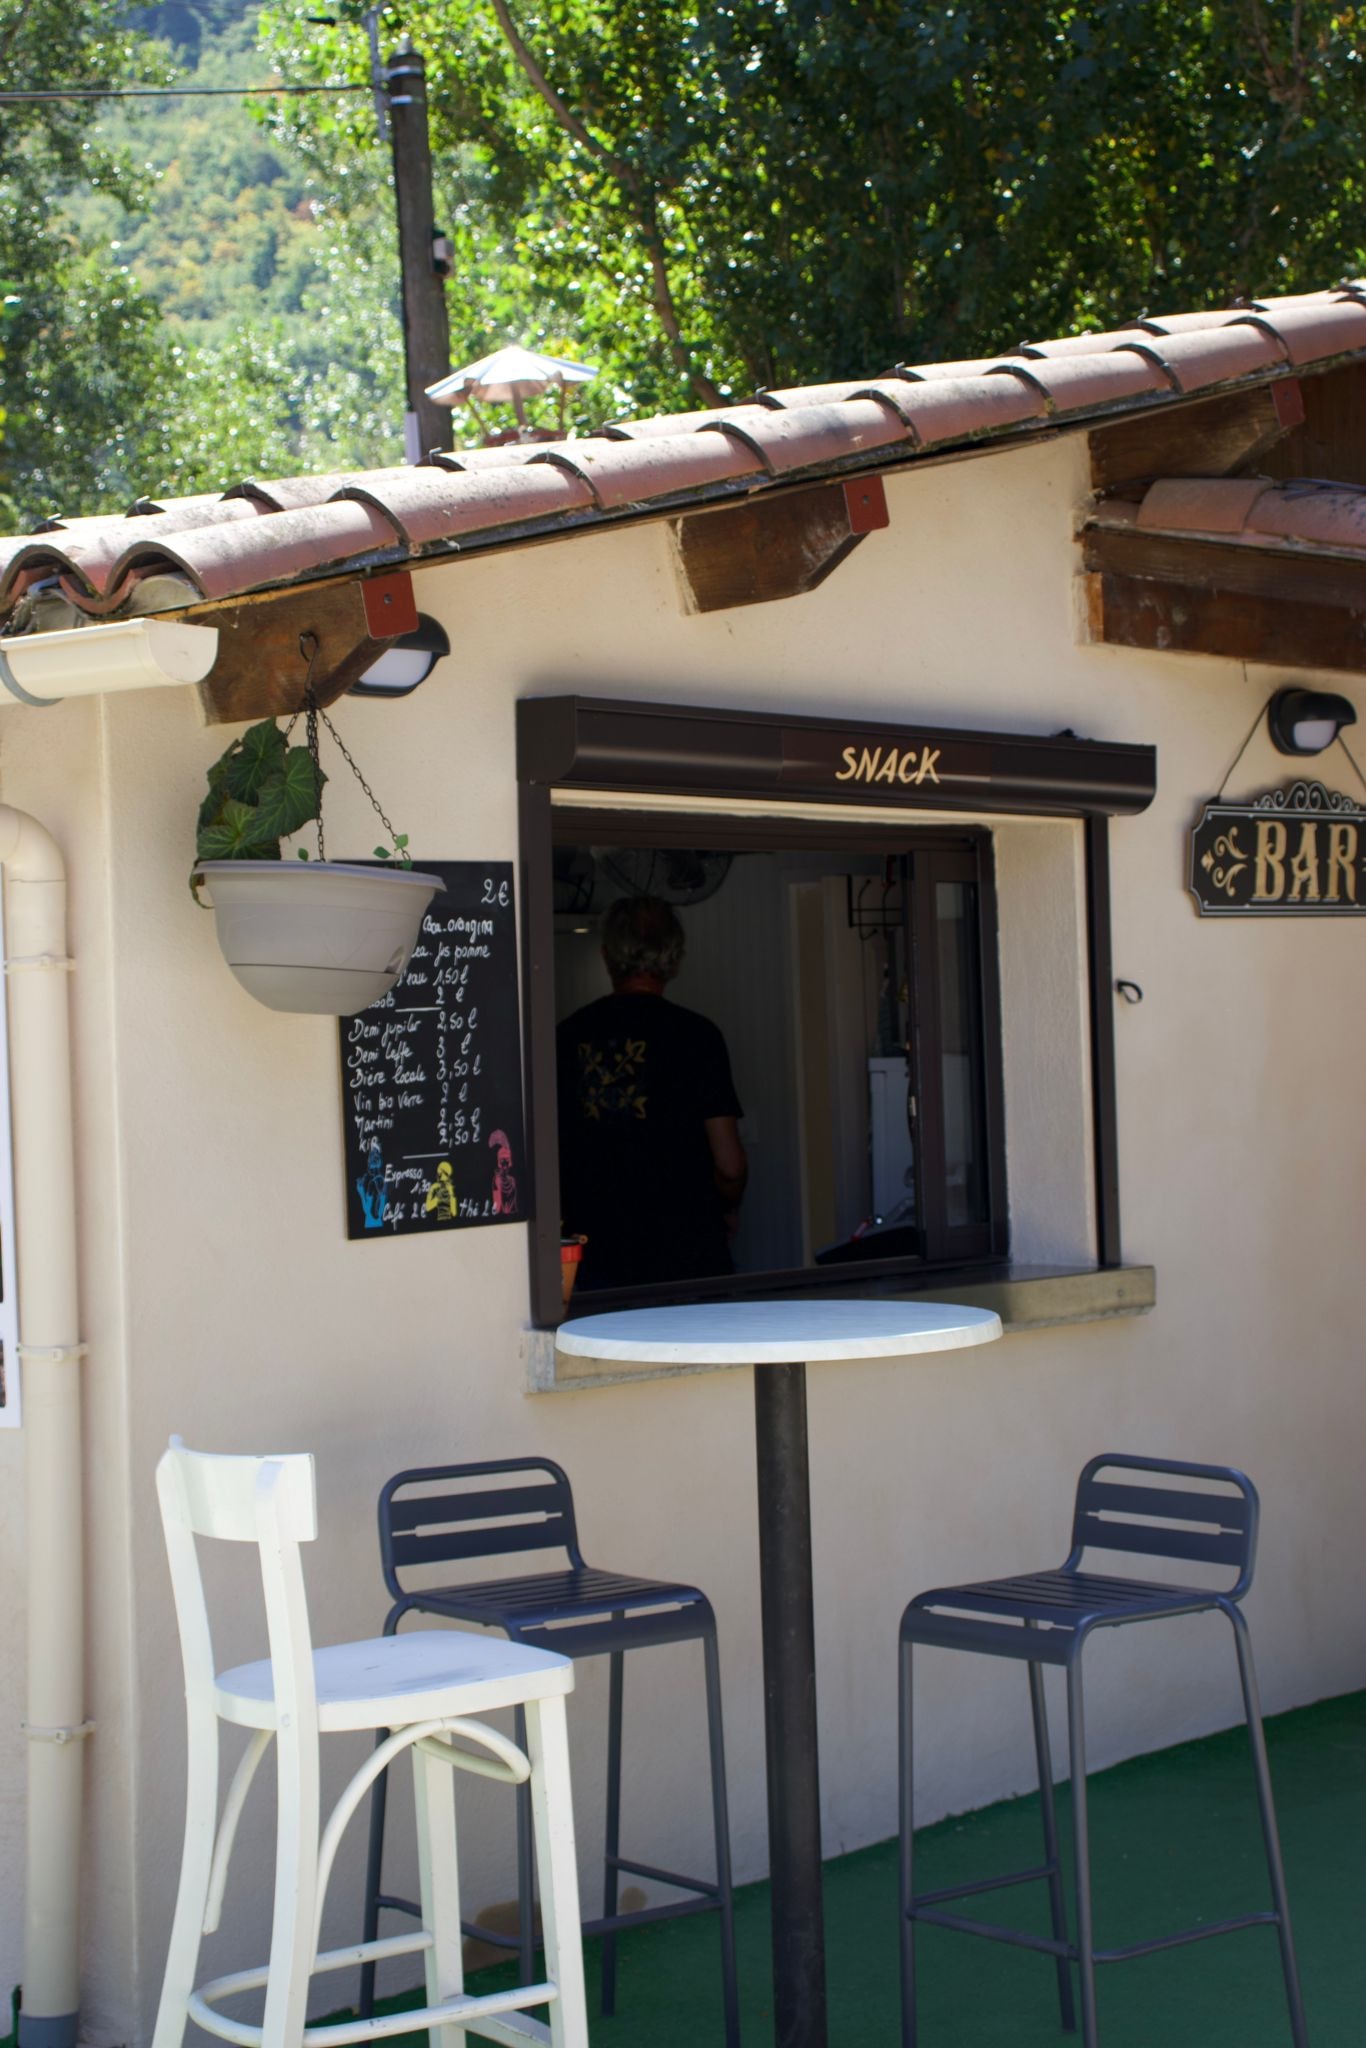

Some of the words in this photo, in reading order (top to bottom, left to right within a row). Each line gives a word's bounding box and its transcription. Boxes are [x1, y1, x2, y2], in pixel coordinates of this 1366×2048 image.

[835, 745, 943, 786] SNACK
[1250, 820, 1360, 903] BAR
[433, 941, 450, 967] jus
[348, 1018, 381, 1043] Demi
[347, 1046, 379, 1068] Demi
[436, 1035, 445, 1059] 3
[354, 1091, 372, 1112] Vin
[378, 1091, 394, 1111] bio
[354, 1113, 395, 1139] Martini
